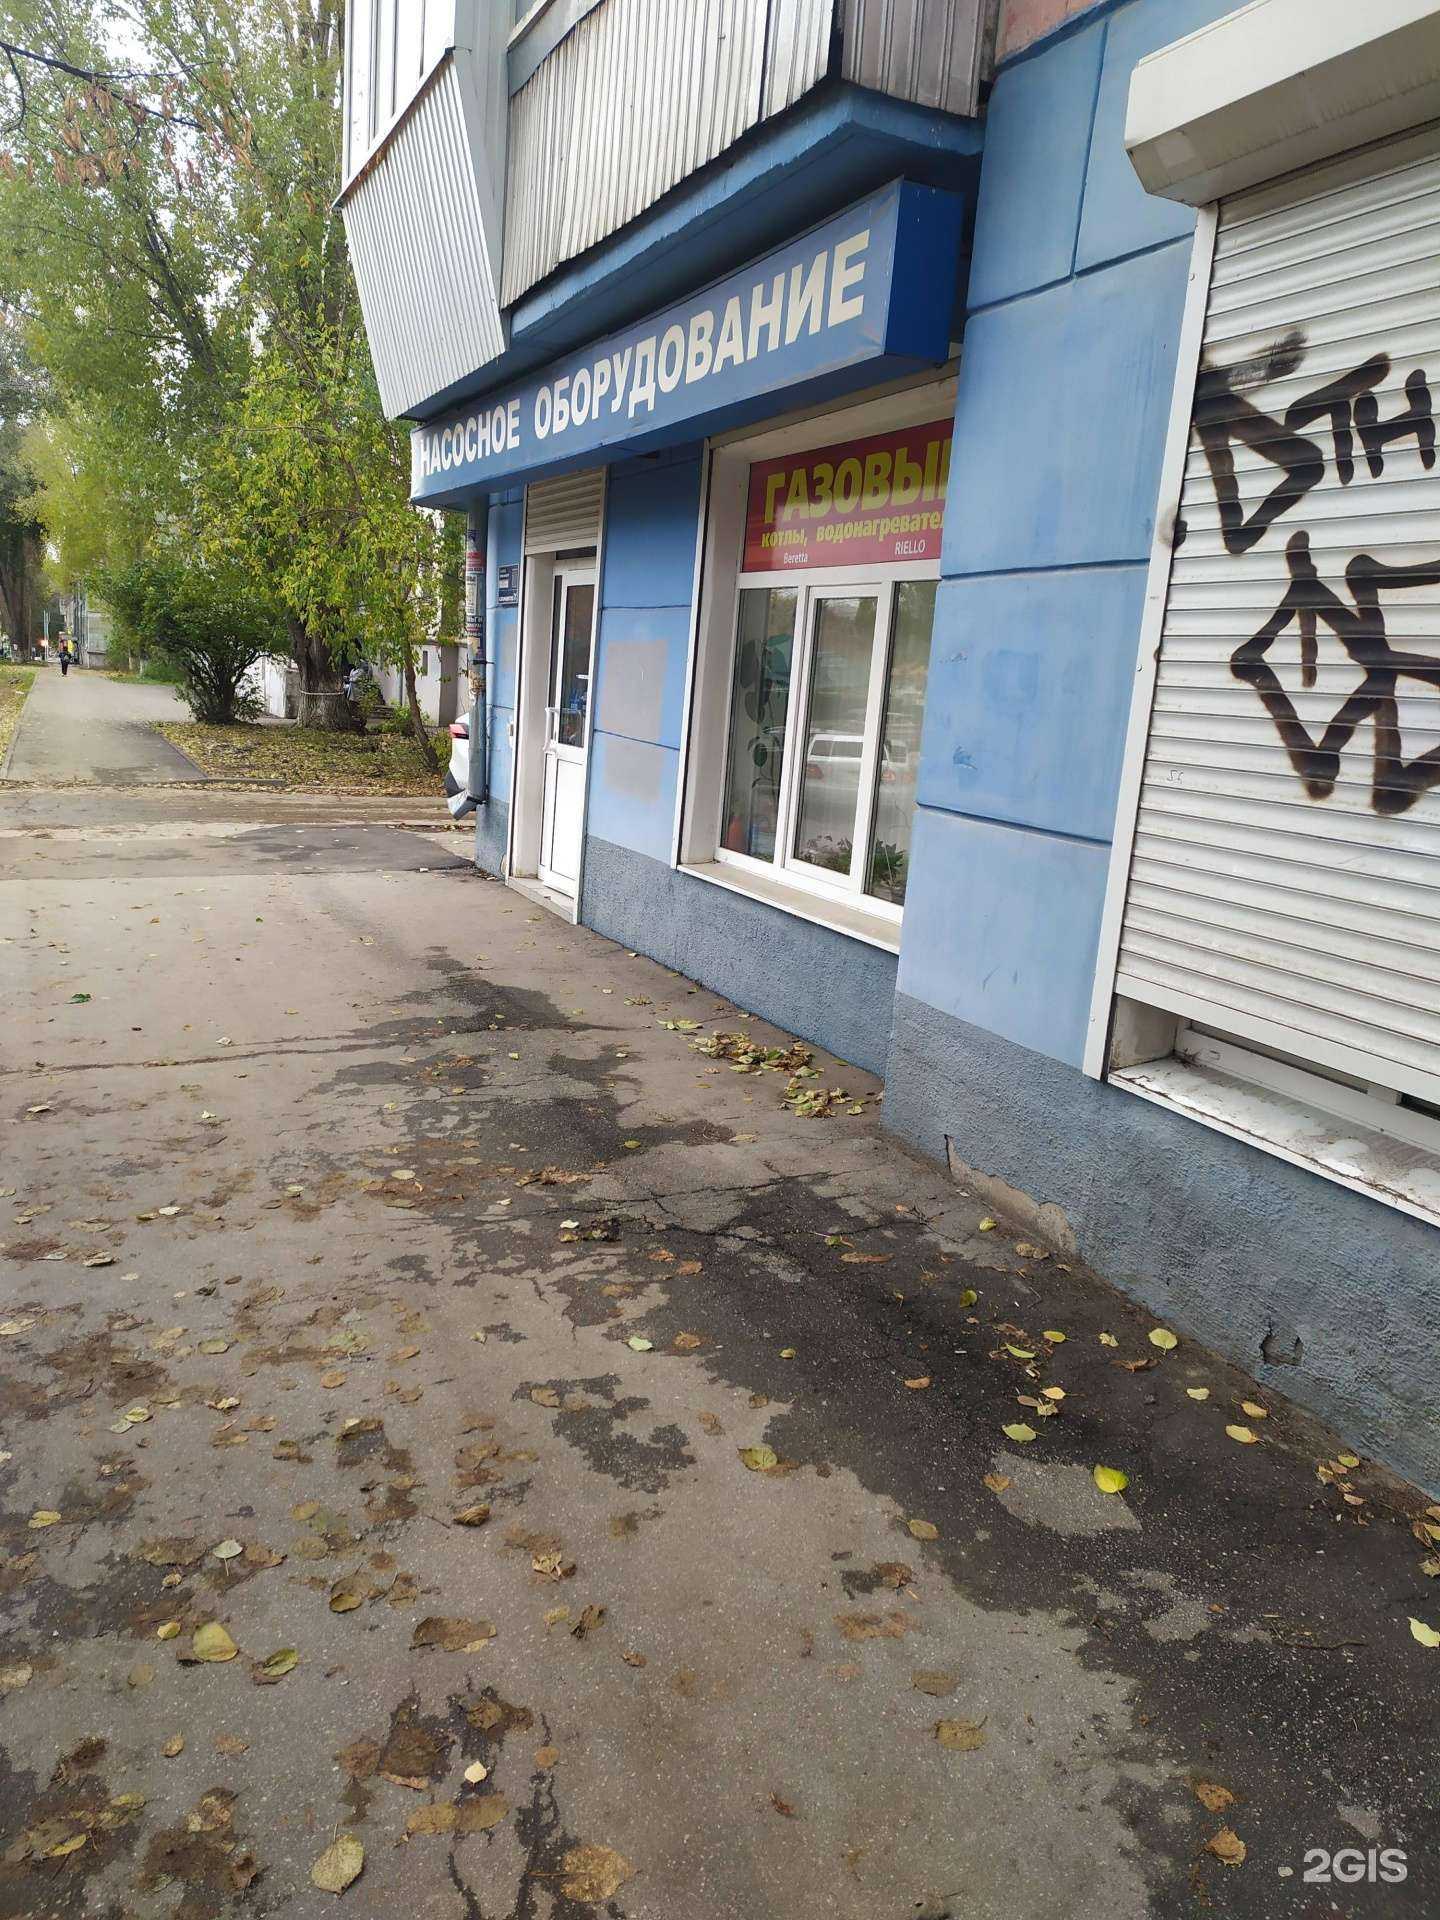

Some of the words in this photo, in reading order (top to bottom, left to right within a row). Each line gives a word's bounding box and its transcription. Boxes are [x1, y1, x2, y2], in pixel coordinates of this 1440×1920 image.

[419, 398, 520, 477] НАСОСНОЕ
[534, 229, 870, 439] ОБОРУДОВАНИЕ
[816, 511, 945, 542] водонагревате
[783, 552, 808, 565] Beretta
[895, 540, 926, 555] RIELLO
